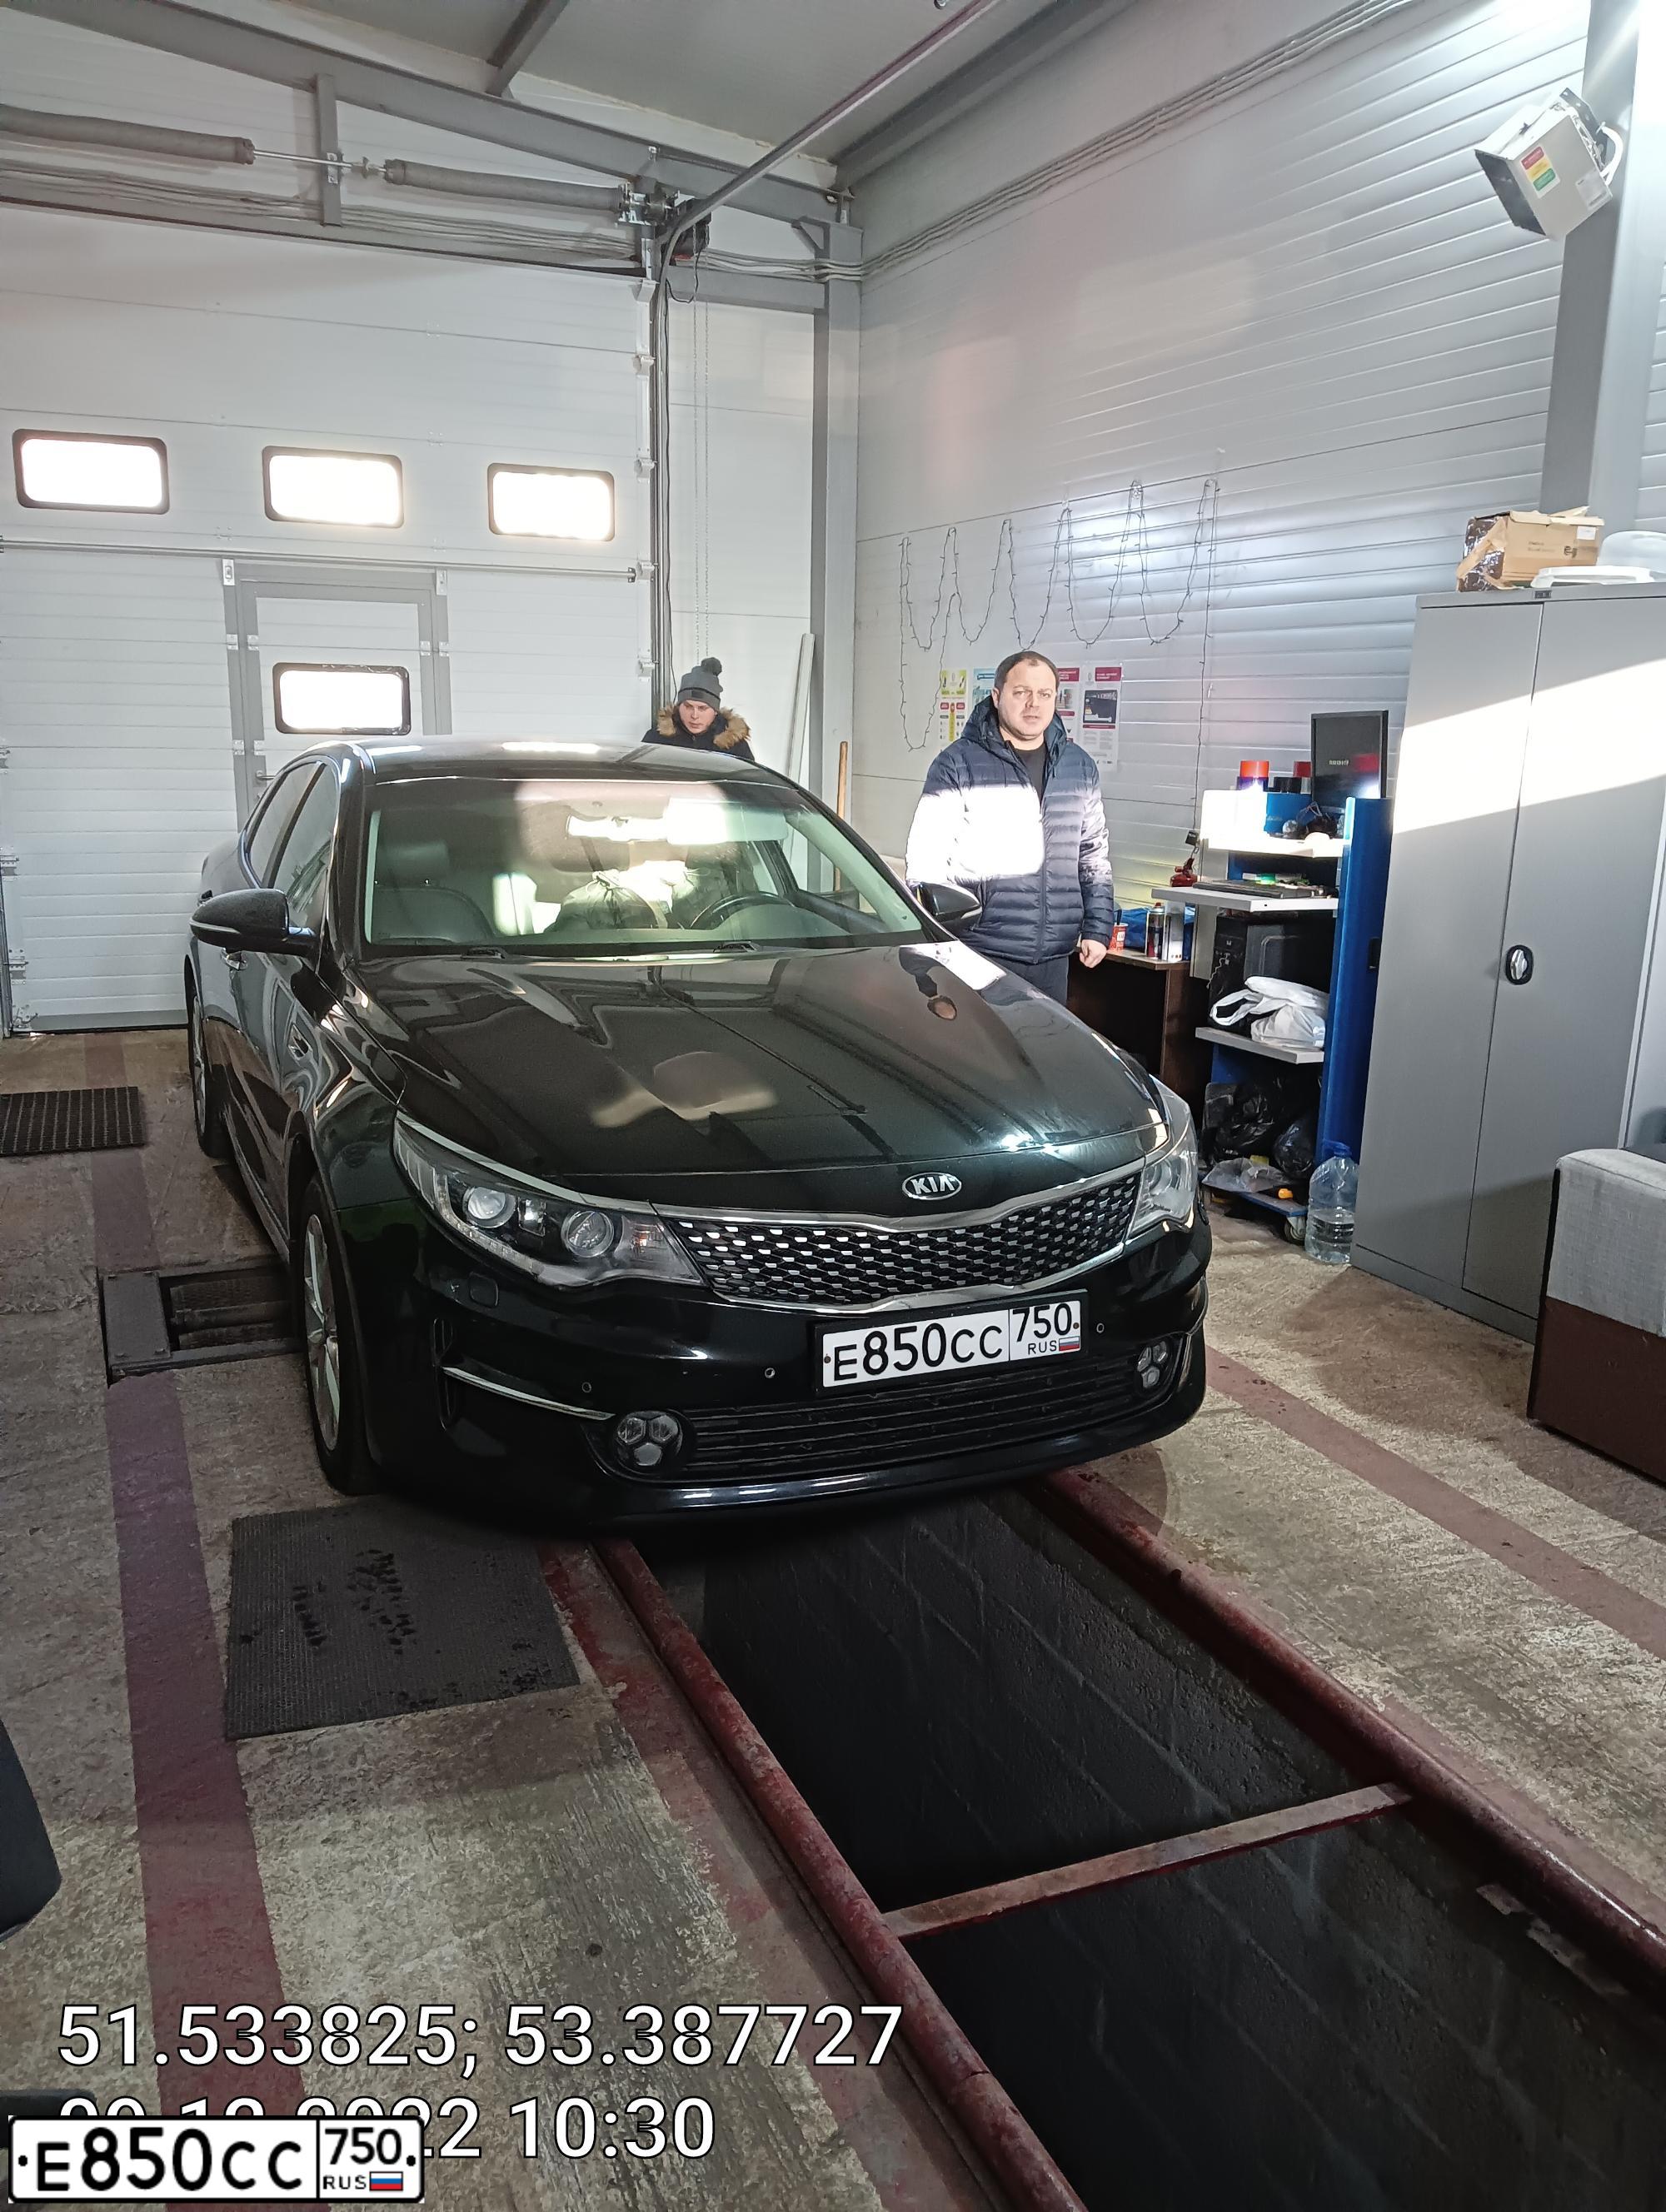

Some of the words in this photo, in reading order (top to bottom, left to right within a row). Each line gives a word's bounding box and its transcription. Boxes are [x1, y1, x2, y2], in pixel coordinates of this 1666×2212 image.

[910, 1174, 955, 1194] KIA
[1012, 1303, 1073, 1343] 750
[1028, 1339, 1057, 1355] RUS
